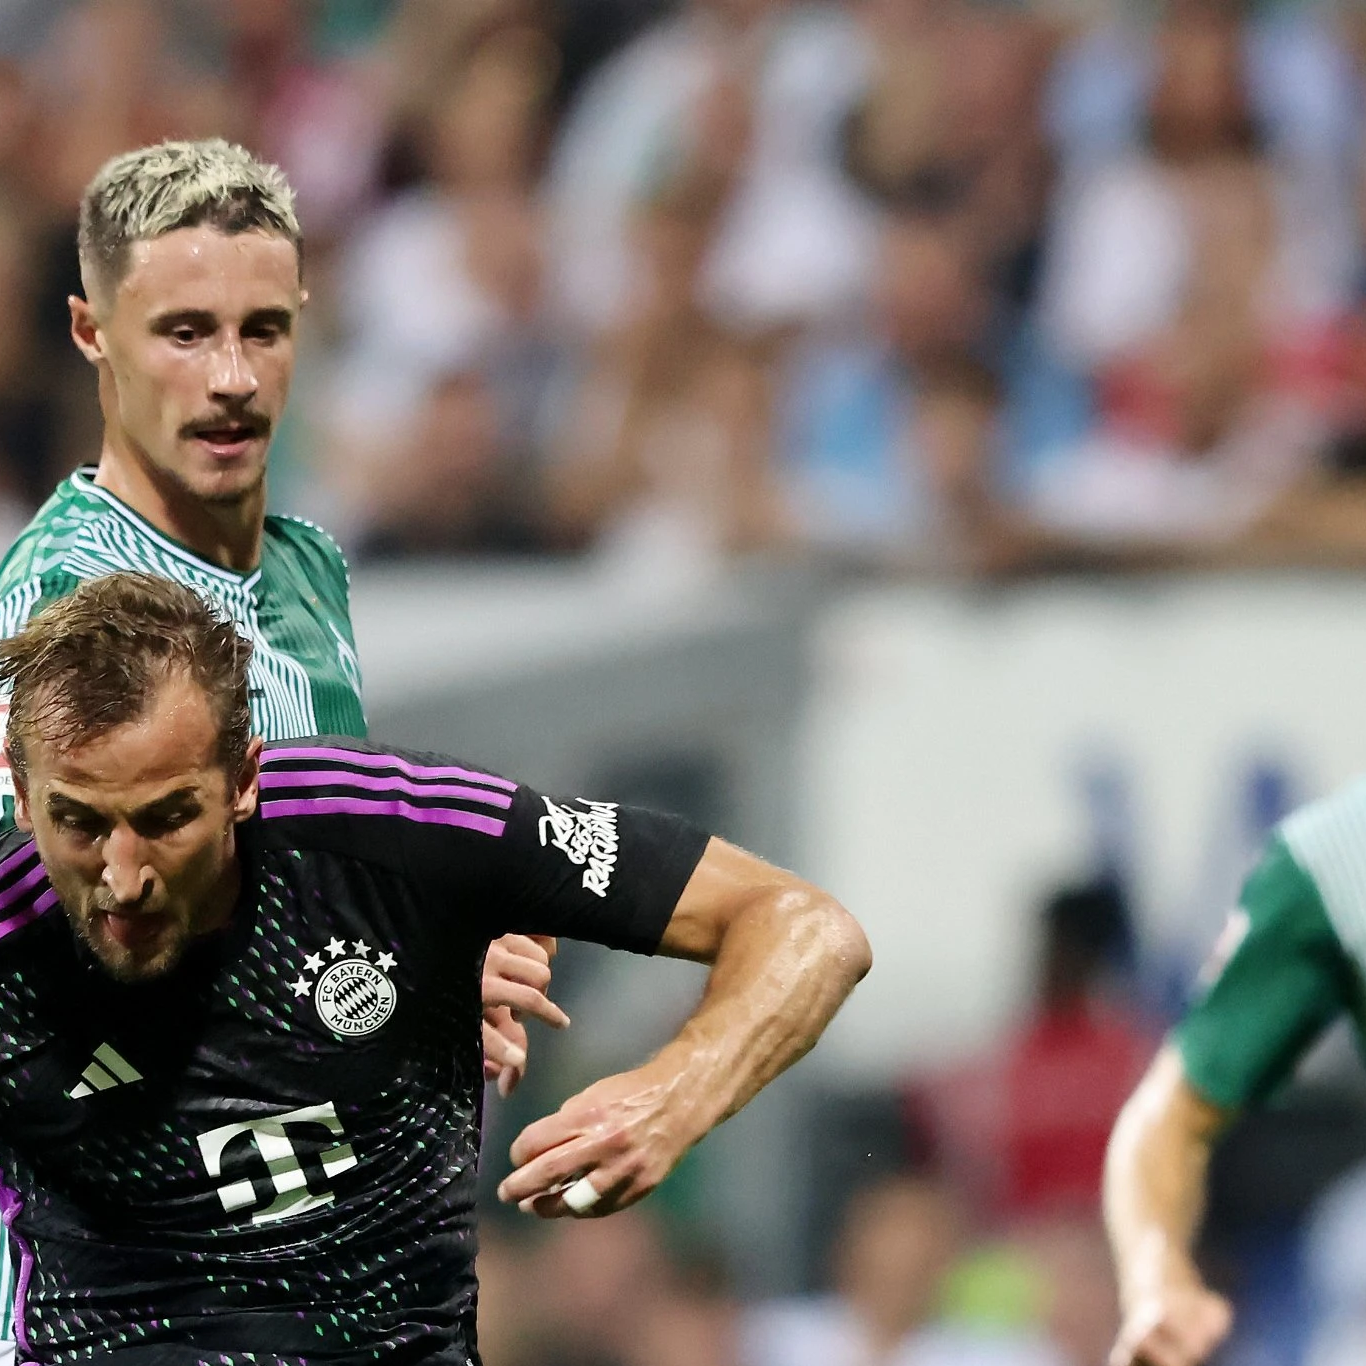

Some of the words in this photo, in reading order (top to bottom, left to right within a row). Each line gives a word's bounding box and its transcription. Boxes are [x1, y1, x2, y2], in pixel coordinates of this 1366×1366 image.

[322, 984, 333, 1003] FC
[330, 965, 382, 985] BAYERN
[330, 996, 391, 1031] MÜNCHEN
